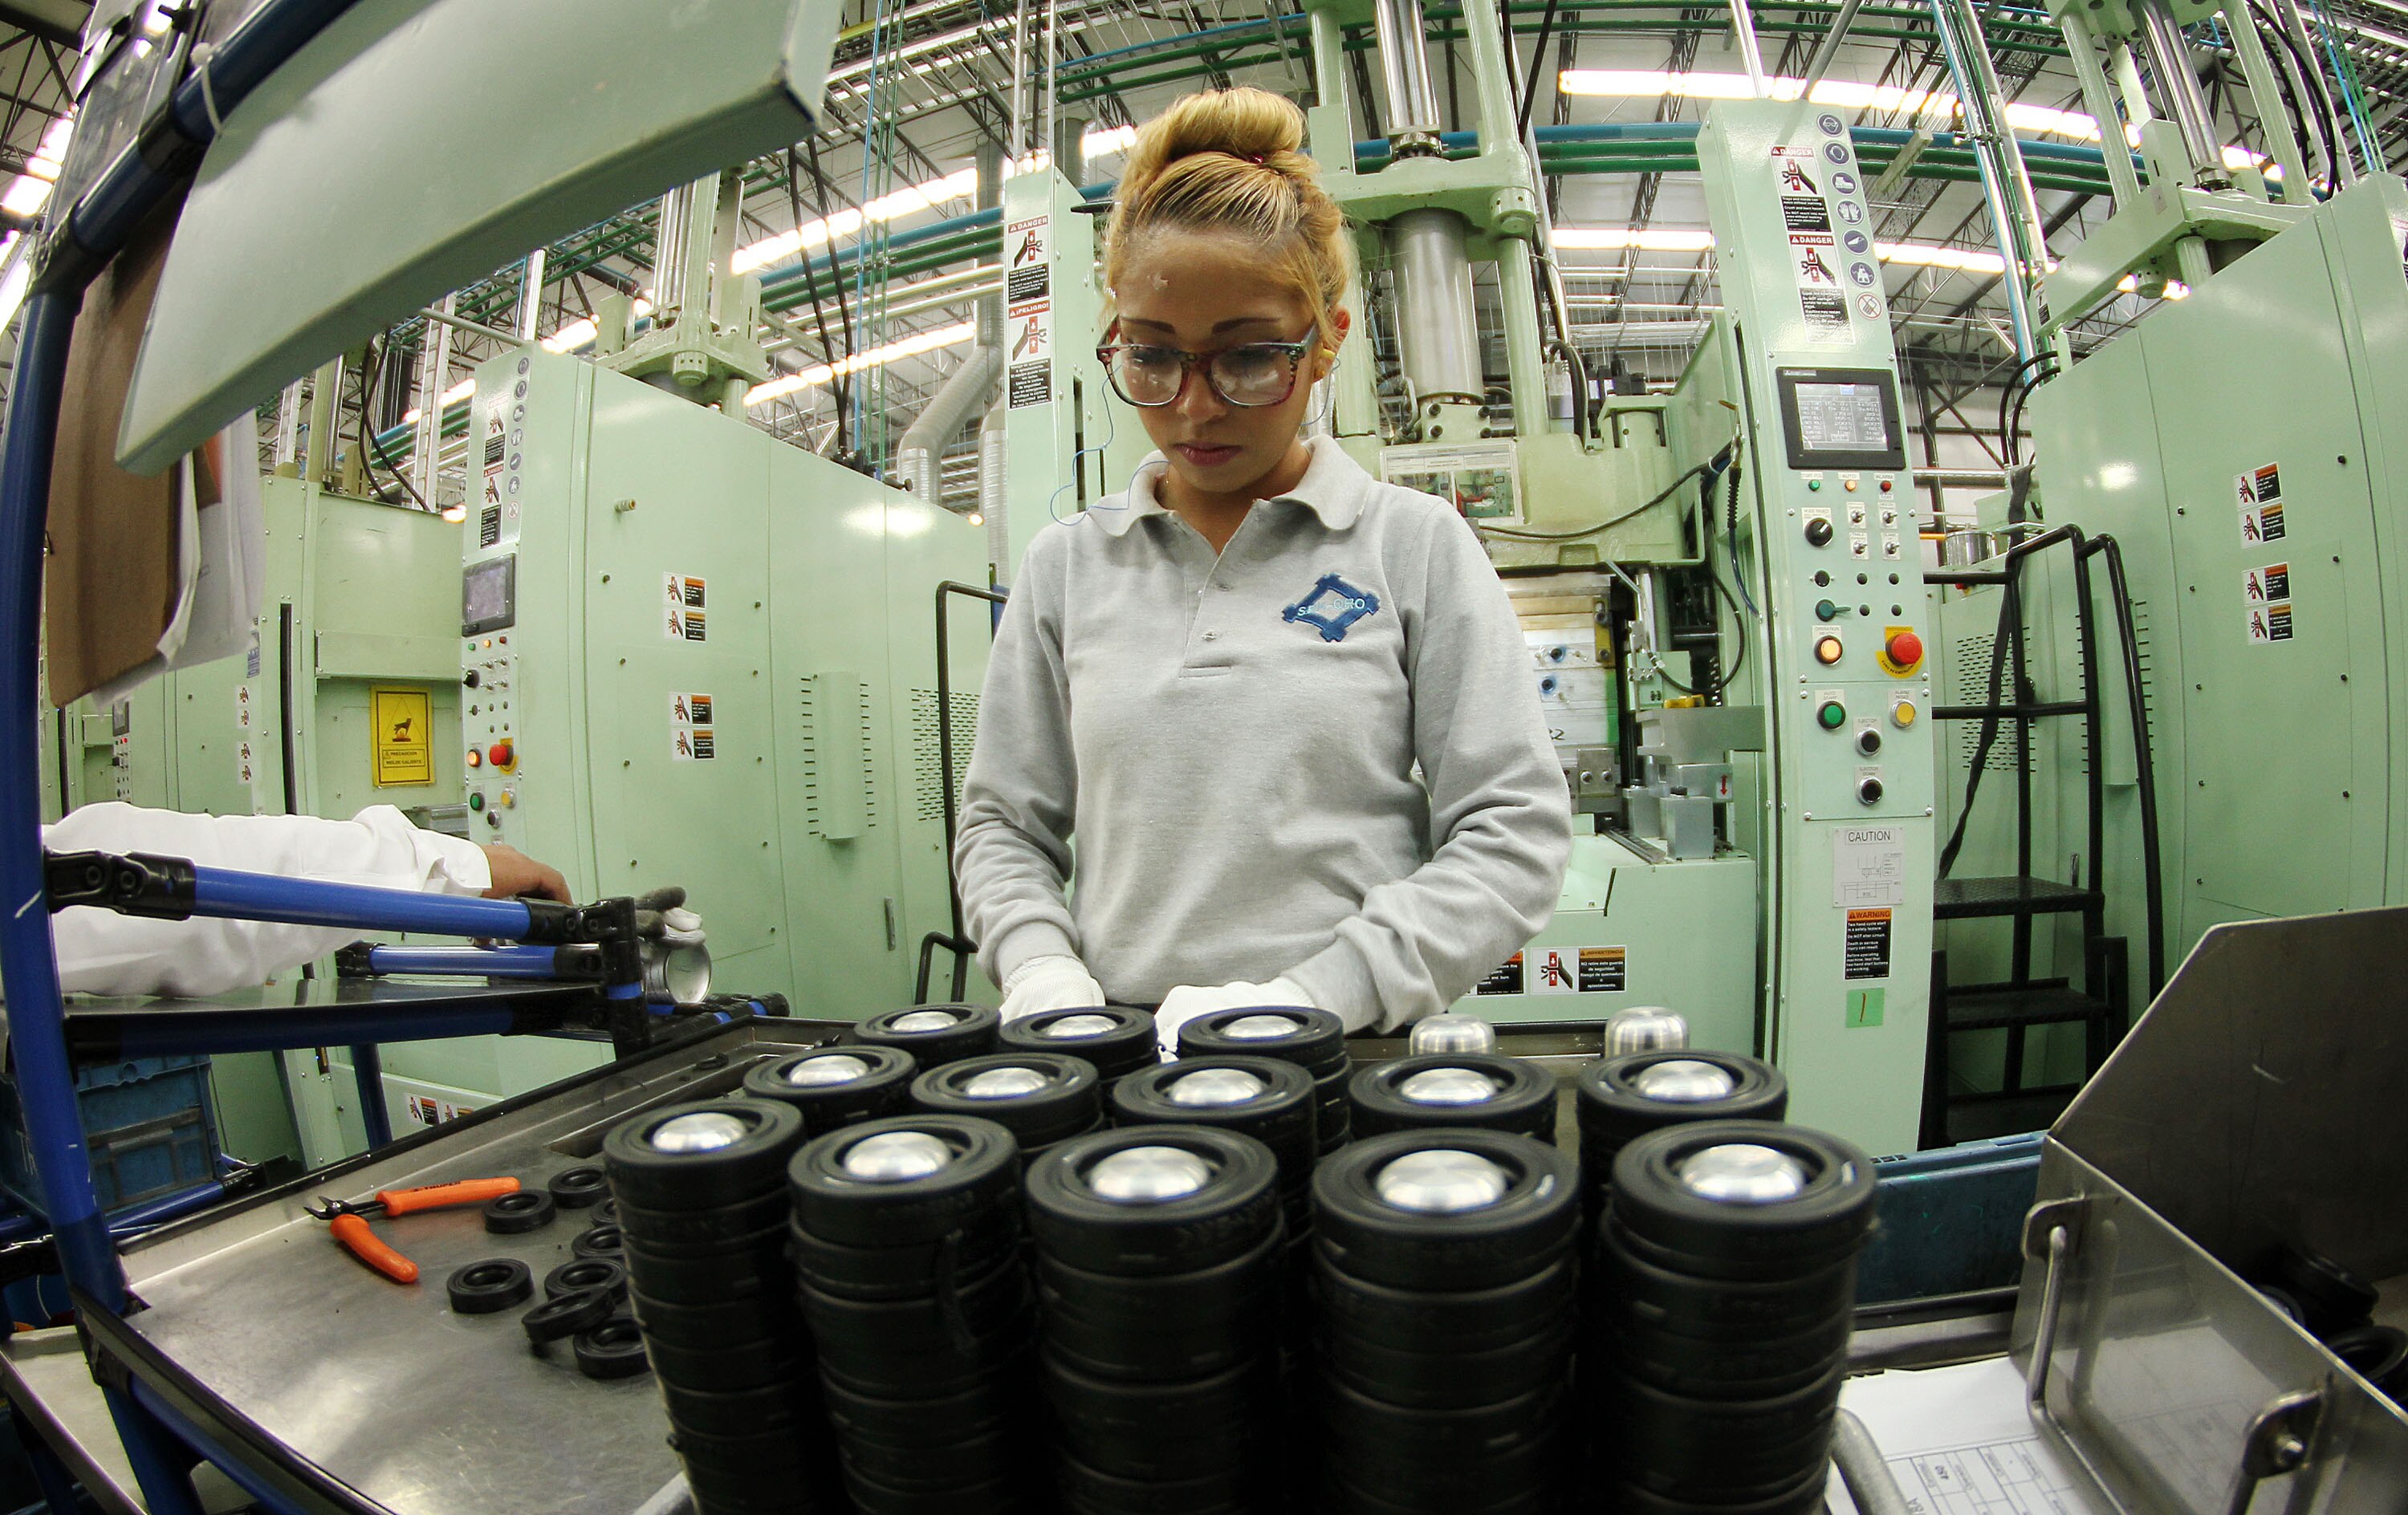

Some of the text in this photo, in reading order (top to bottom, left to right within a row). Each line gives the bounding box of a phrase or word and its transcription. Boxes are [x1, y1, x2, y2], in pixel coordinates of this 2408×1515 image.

[1781, 148, 1812, 156] DANGER
[1018, 217, 1047, 229] DANGER
[1848, 830, 1891, 842] CAUTION
[424, 1181, 461, 1190] TRUPER
